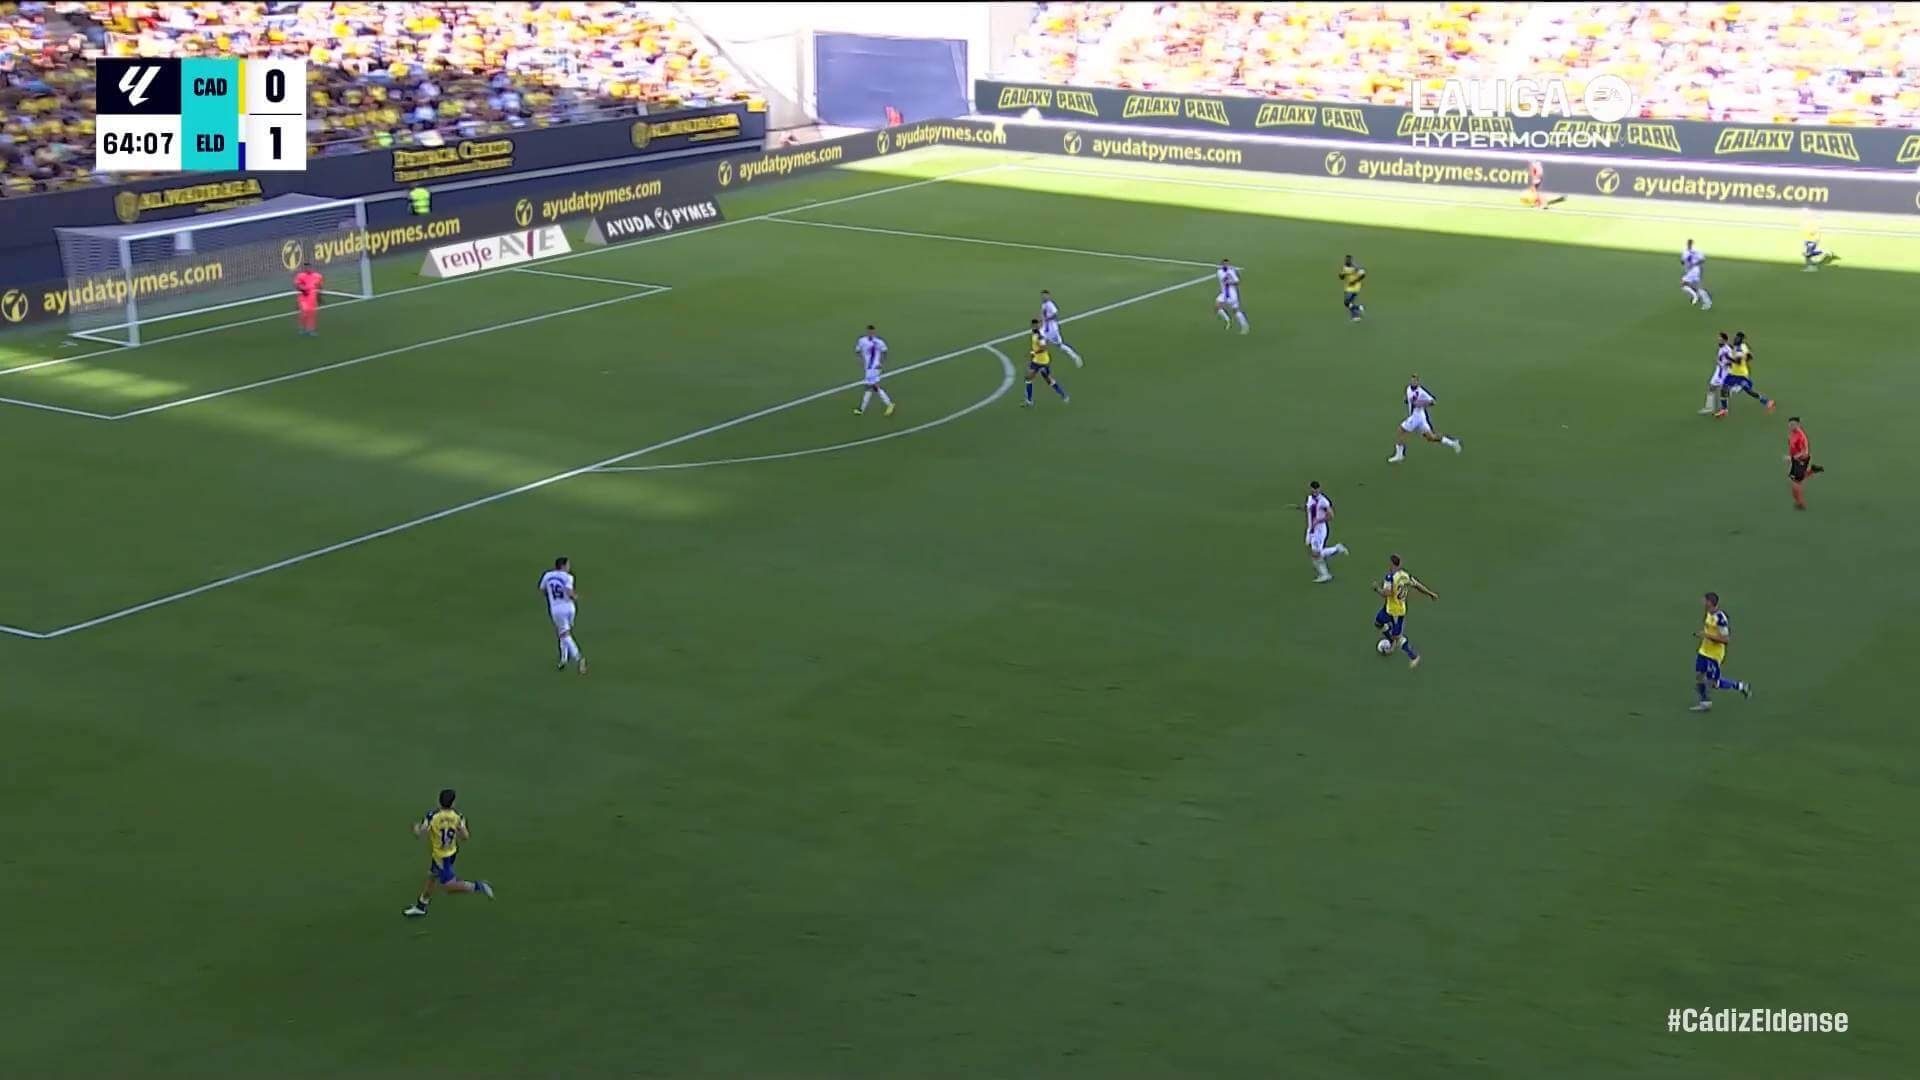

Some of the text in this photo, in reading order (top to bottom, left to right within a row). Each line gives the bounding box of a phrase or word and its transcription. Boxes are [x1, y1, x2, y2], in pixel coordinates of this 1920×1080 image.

[998, 87, 1098, 116] GALAXY PARK
[1123, 95, 1230, 126] GALAXY PARK
[1255, 103, 1369, 134] GALAXY PARK
[1397, 112, 1463, 136] GALAXY
[895, 124, 1007, 147] ayudatpymes.com
[1093, 137, 1242, 164] ayudatpymes.com
[1627, 123, 1681, 152] PARK
[1715, 127, 1860, 161] GALAXY PARK
[739, 143, 842, 179] ayudatpymes.com
[1357, 157, 1529, 185] ayudatpymes.com
[542, 179, 661, 223] ayudatpymes.com
[1633, 174, 1829, 203] ayudatpymes.com
[606, 201, 717, 238] AYUDA PYMES
[314, 217, 460, 264] ayudatpymes.com
[441, 240, 493, 271] renfe
[43, 261, 223, 315] ayudatpymes.com
[440, 826, 457, 848] 19
